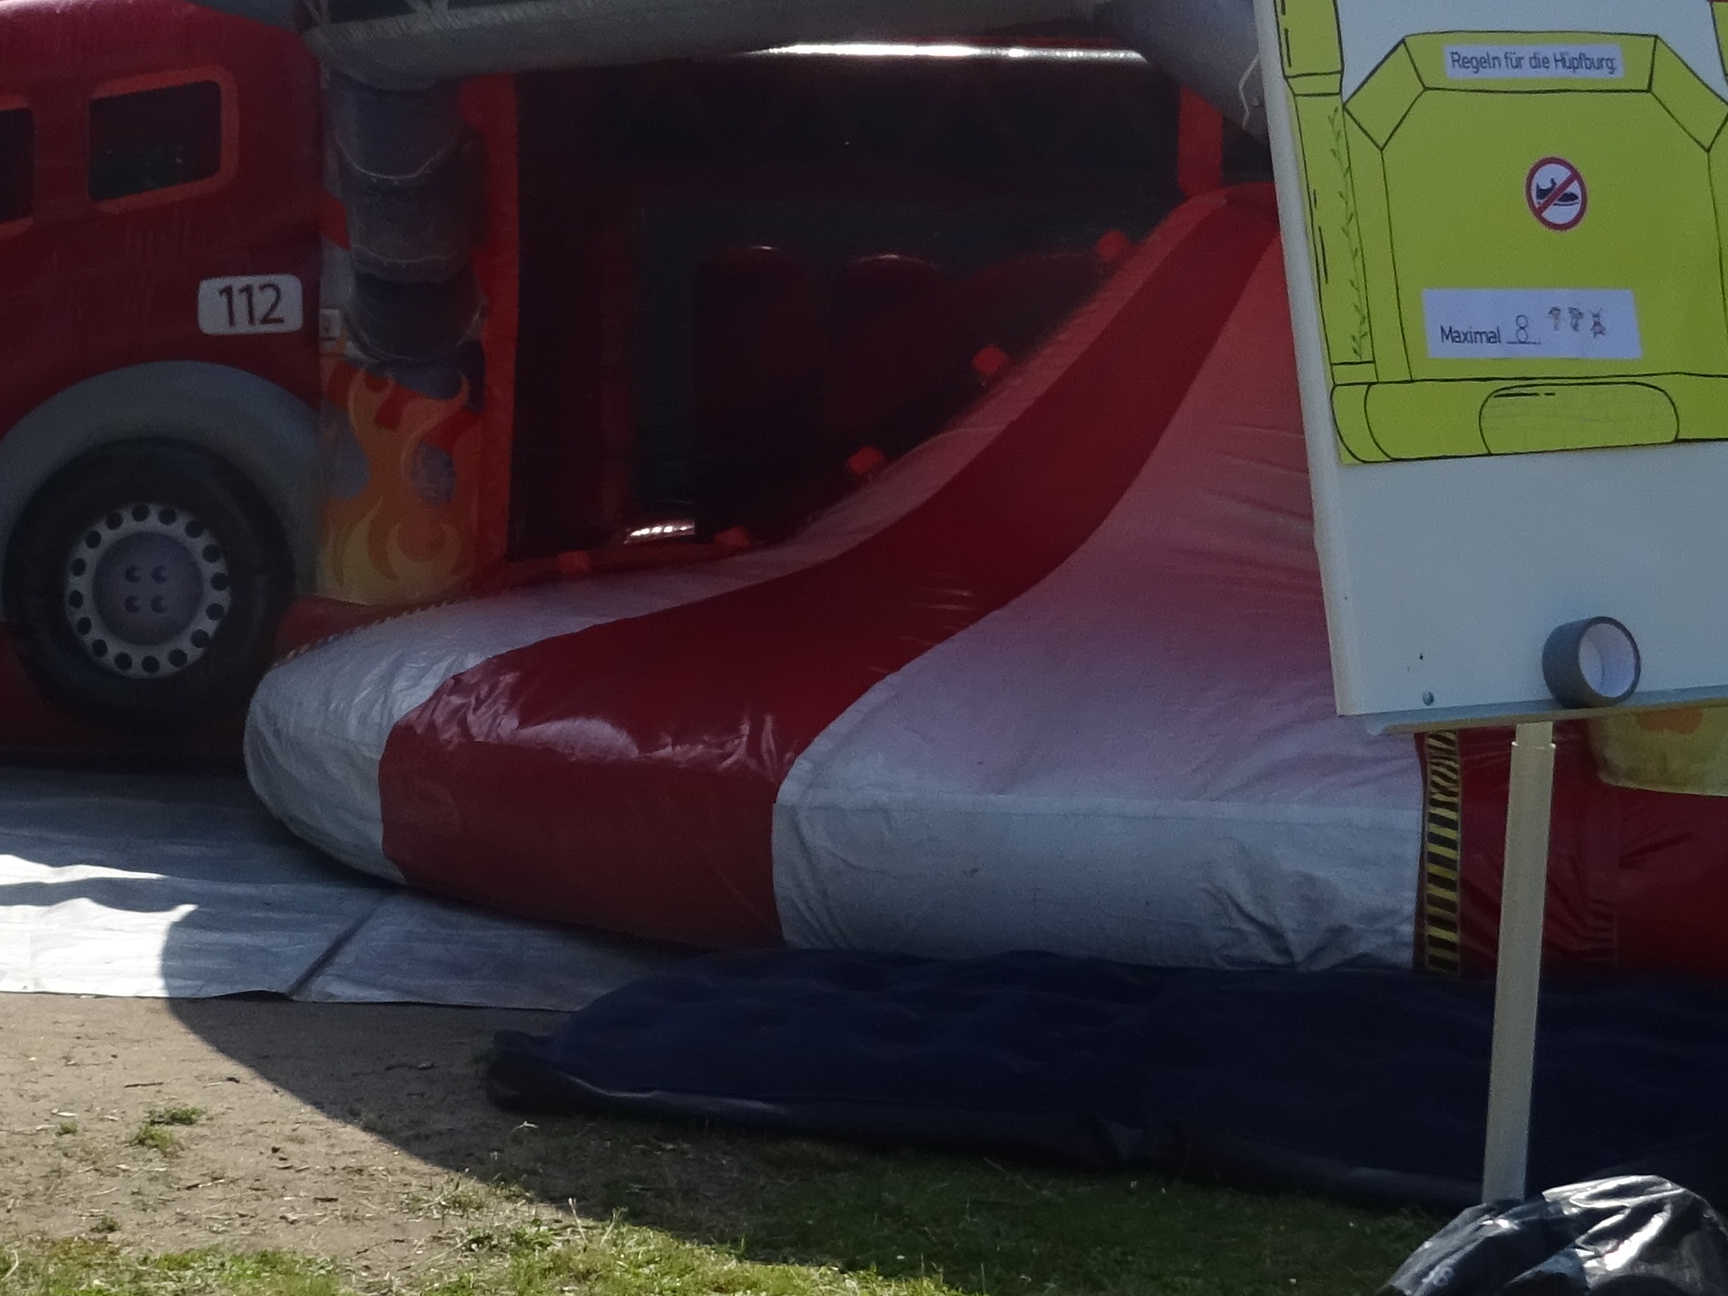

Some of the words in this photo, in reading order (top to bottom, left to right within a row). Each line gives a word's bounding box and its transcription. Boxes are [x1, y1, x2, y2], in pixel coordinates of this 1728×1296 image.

[1450, 51, 1502, 74] Regeln
[1504, 51, 1524, 70] für
[1528, 51, 1550, 70] die
[218, 282, 285, 327] 112
[1440, 325, 1502, 344] Maximal
